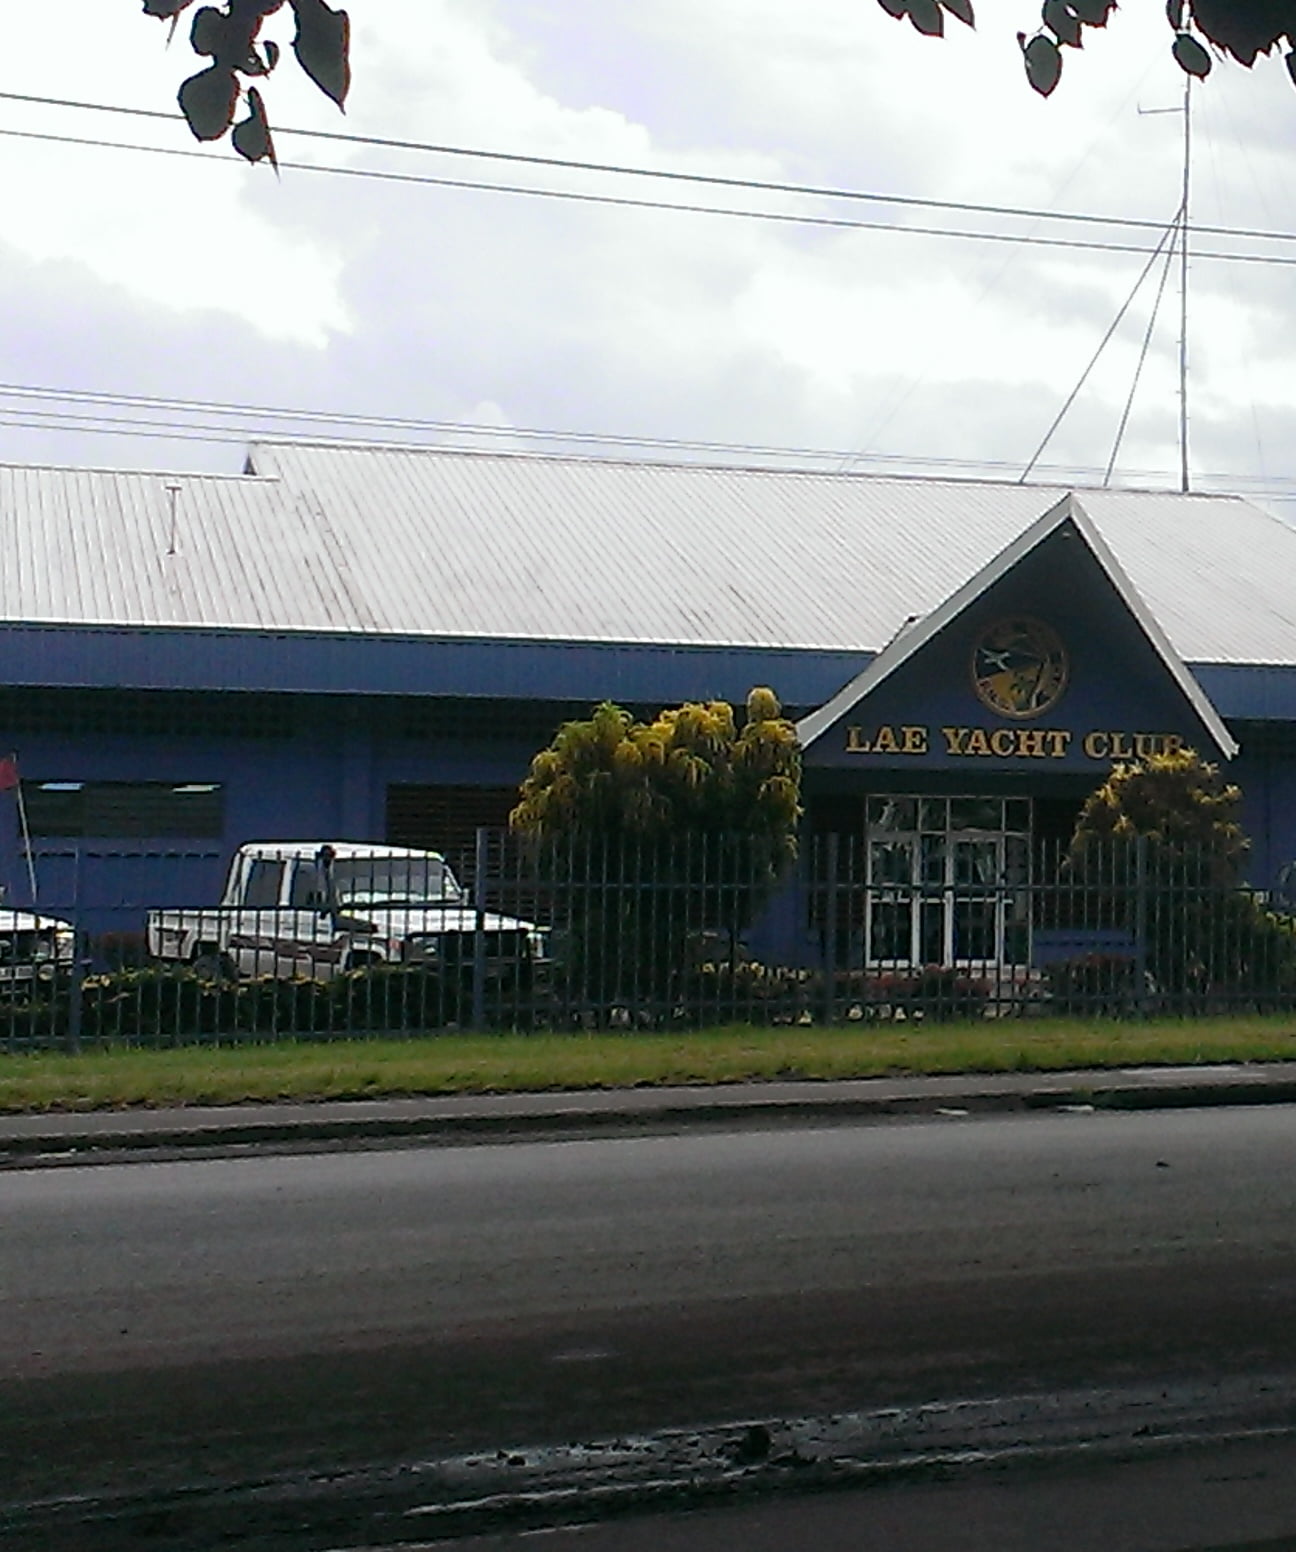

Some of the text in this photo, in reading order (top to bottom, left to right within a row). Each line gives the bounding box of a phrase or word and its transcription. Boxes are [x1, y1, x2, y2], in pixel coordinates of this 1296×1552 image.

[845, 726, 1184, 760] LAE YACHT CLUB
